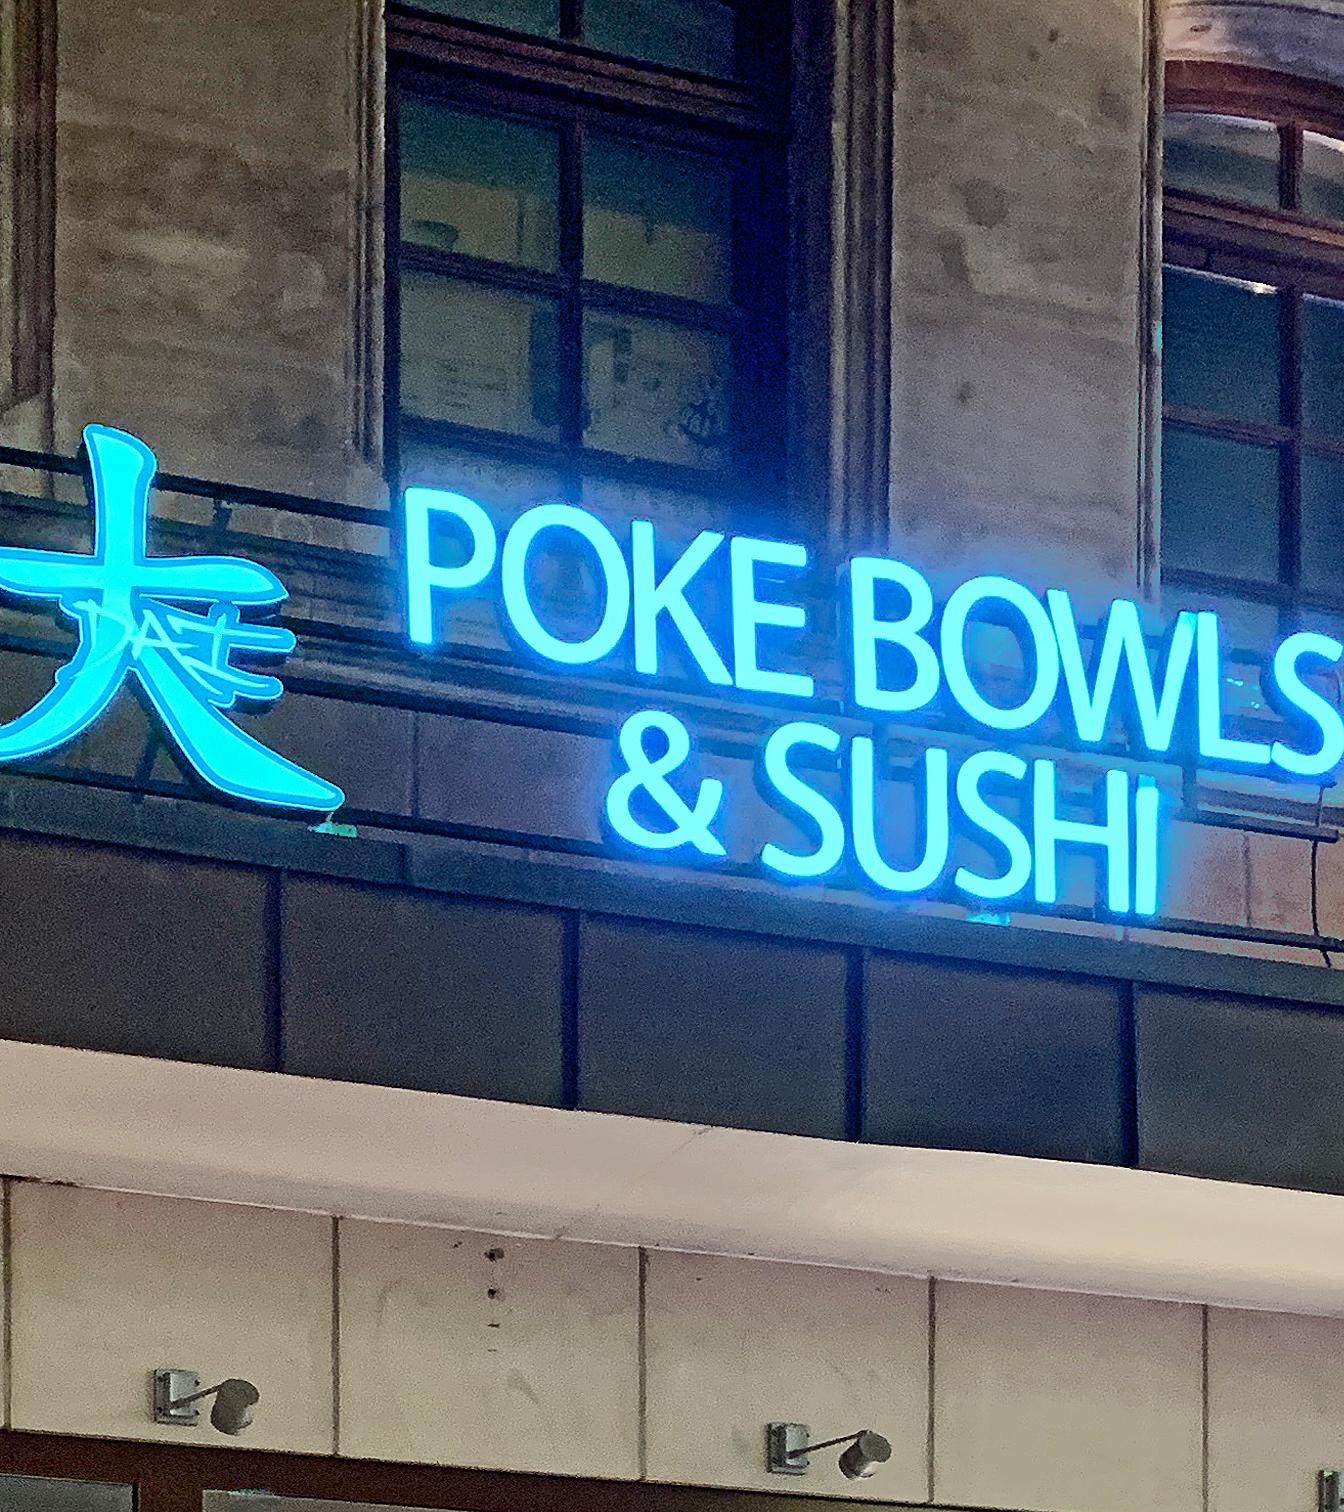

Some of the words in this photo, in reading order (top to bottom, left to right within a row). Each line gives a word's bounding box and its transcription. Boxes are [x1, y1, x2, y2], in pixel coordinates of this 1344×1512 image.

[402, 485, 815, 700] POKE
[606, 708, 726, 855] &
[759, 720, 1160, 916] SUSHI
